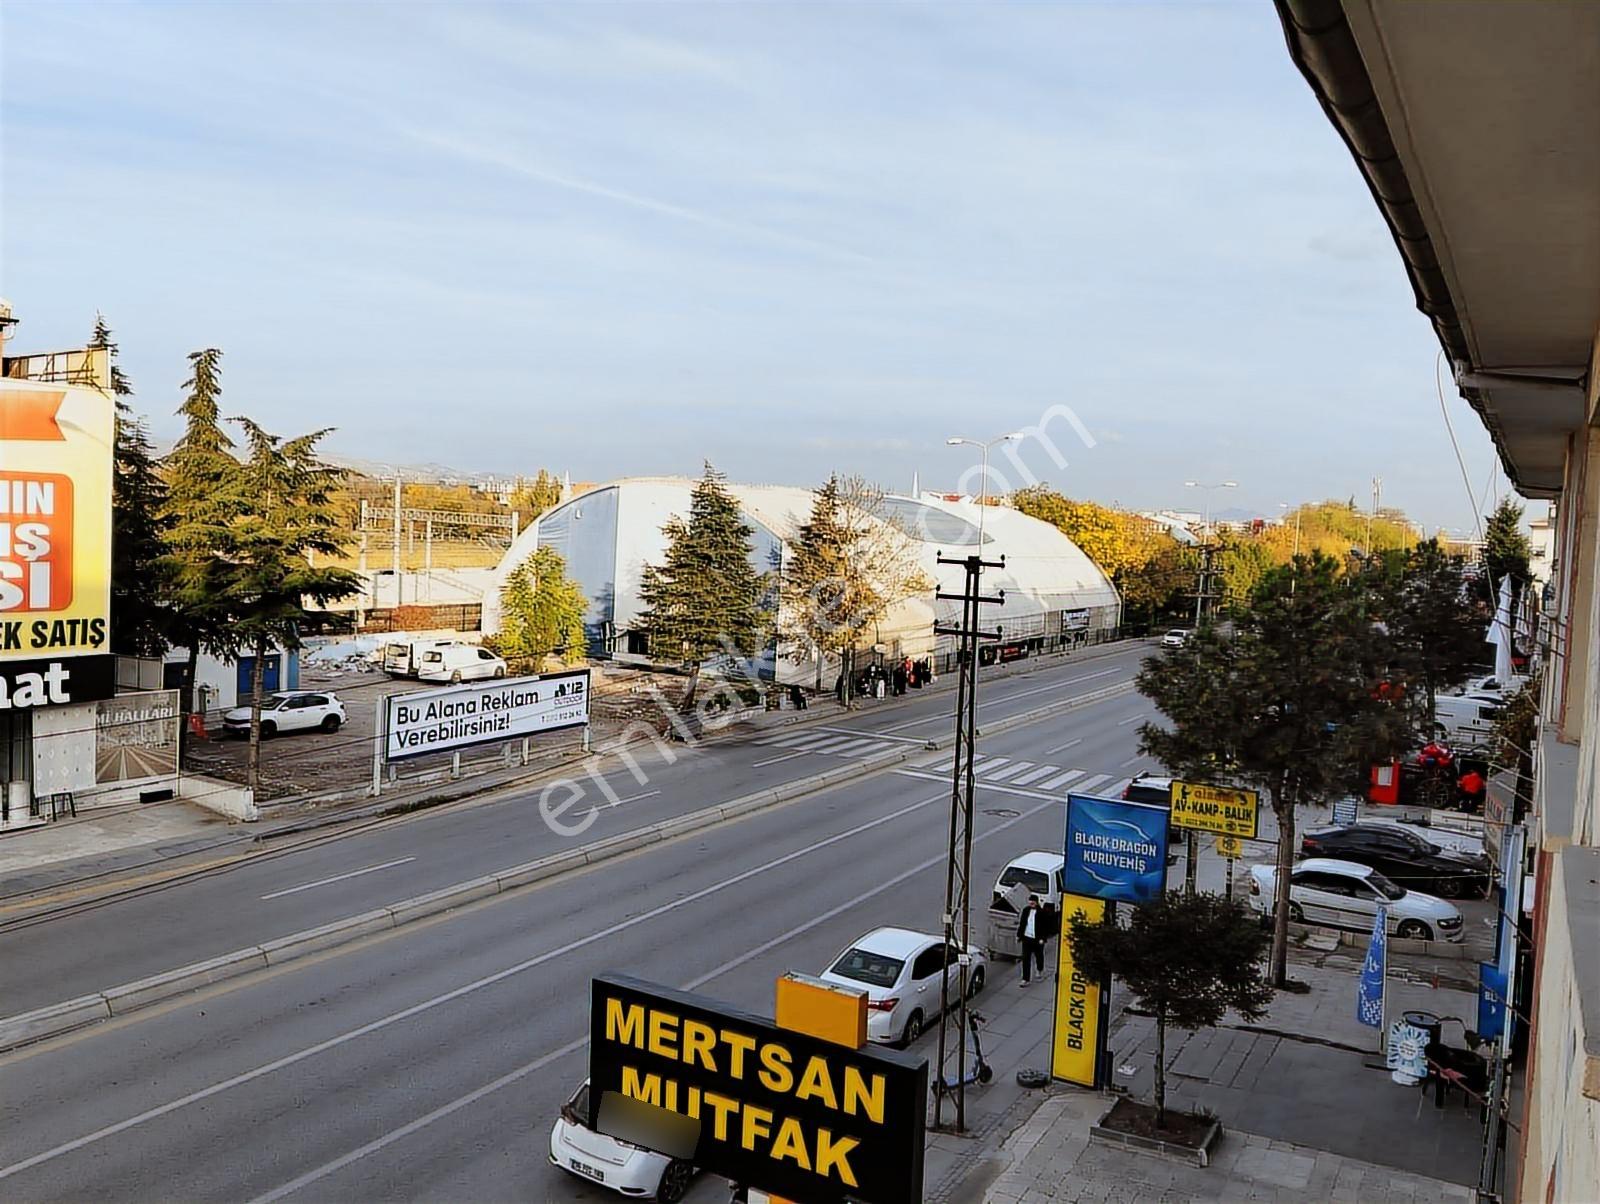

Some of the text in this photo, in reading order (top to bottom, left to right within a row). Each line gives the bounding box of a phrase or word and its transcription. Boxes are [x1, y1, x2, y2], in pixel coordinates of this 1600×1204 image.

[0, 618, 105, 650] K SATIŞ
[397, 690, 539, 725] Bu Alana Reklam
[396, 712, 510, 749] Verebilirsiniz!
[1067, 997, 1085, 1050] BLACK
[605, 997, 887, 1125] MERTSAN
[621, 1065, 862, 1188] MUTFAK
